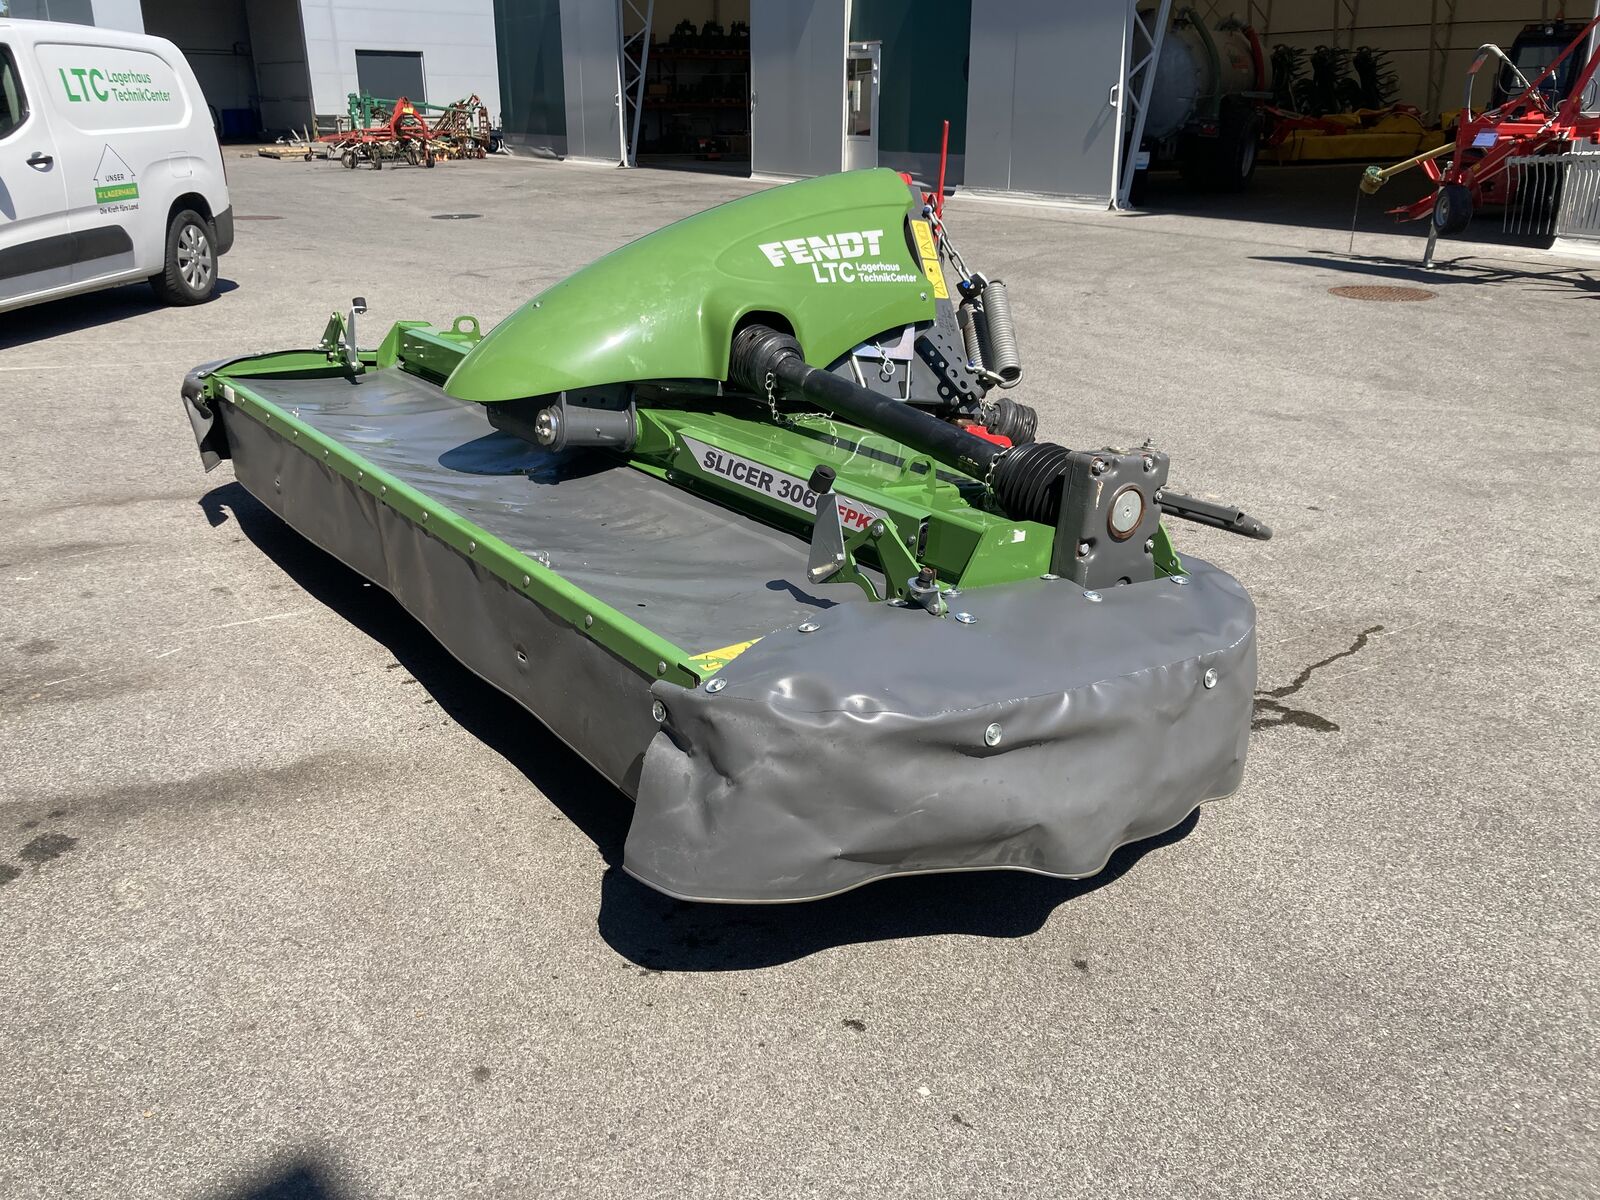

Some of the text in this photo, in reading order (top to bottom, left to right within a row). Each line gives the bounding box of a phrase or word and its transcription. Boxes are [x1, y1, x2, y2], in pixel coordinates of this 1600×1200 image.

[58, 68, 109, 102] LTC
[105, 69, 152, 86] Lagerhaus
[111, 88, 171, 102] TechnikCenter
[105, 173, 125, 182] UNSER
[758, 229, 884, 268] FENDT
[811, 262, 856, 284] LTC
[855, 262, 900, 273] Lagerhaus
[858, 272, 917, 283] TechnikCenter
[703, 450, 774, 493] SLICER
[777, 479, 817, 509] 306
